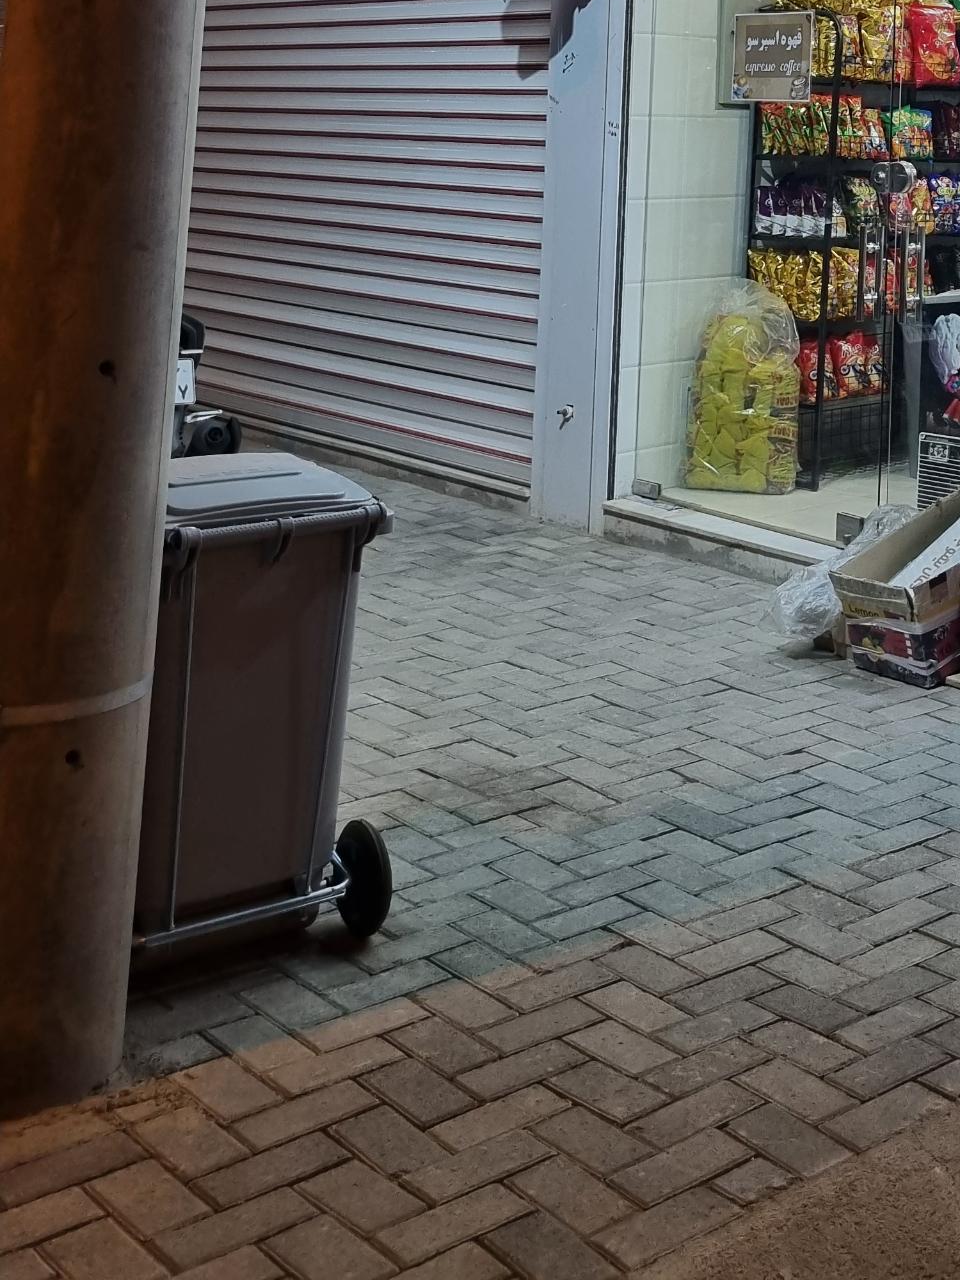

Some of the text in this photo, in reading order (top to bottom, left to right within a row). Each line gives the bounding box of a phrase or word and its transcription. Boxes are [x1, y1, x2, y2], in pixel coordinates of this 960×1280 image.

[745, 27, 802, 51] قهوه اسپرسو
[745, 59, 801, 76] espresso coffee
[849, 604, 879, 617] Lemon
